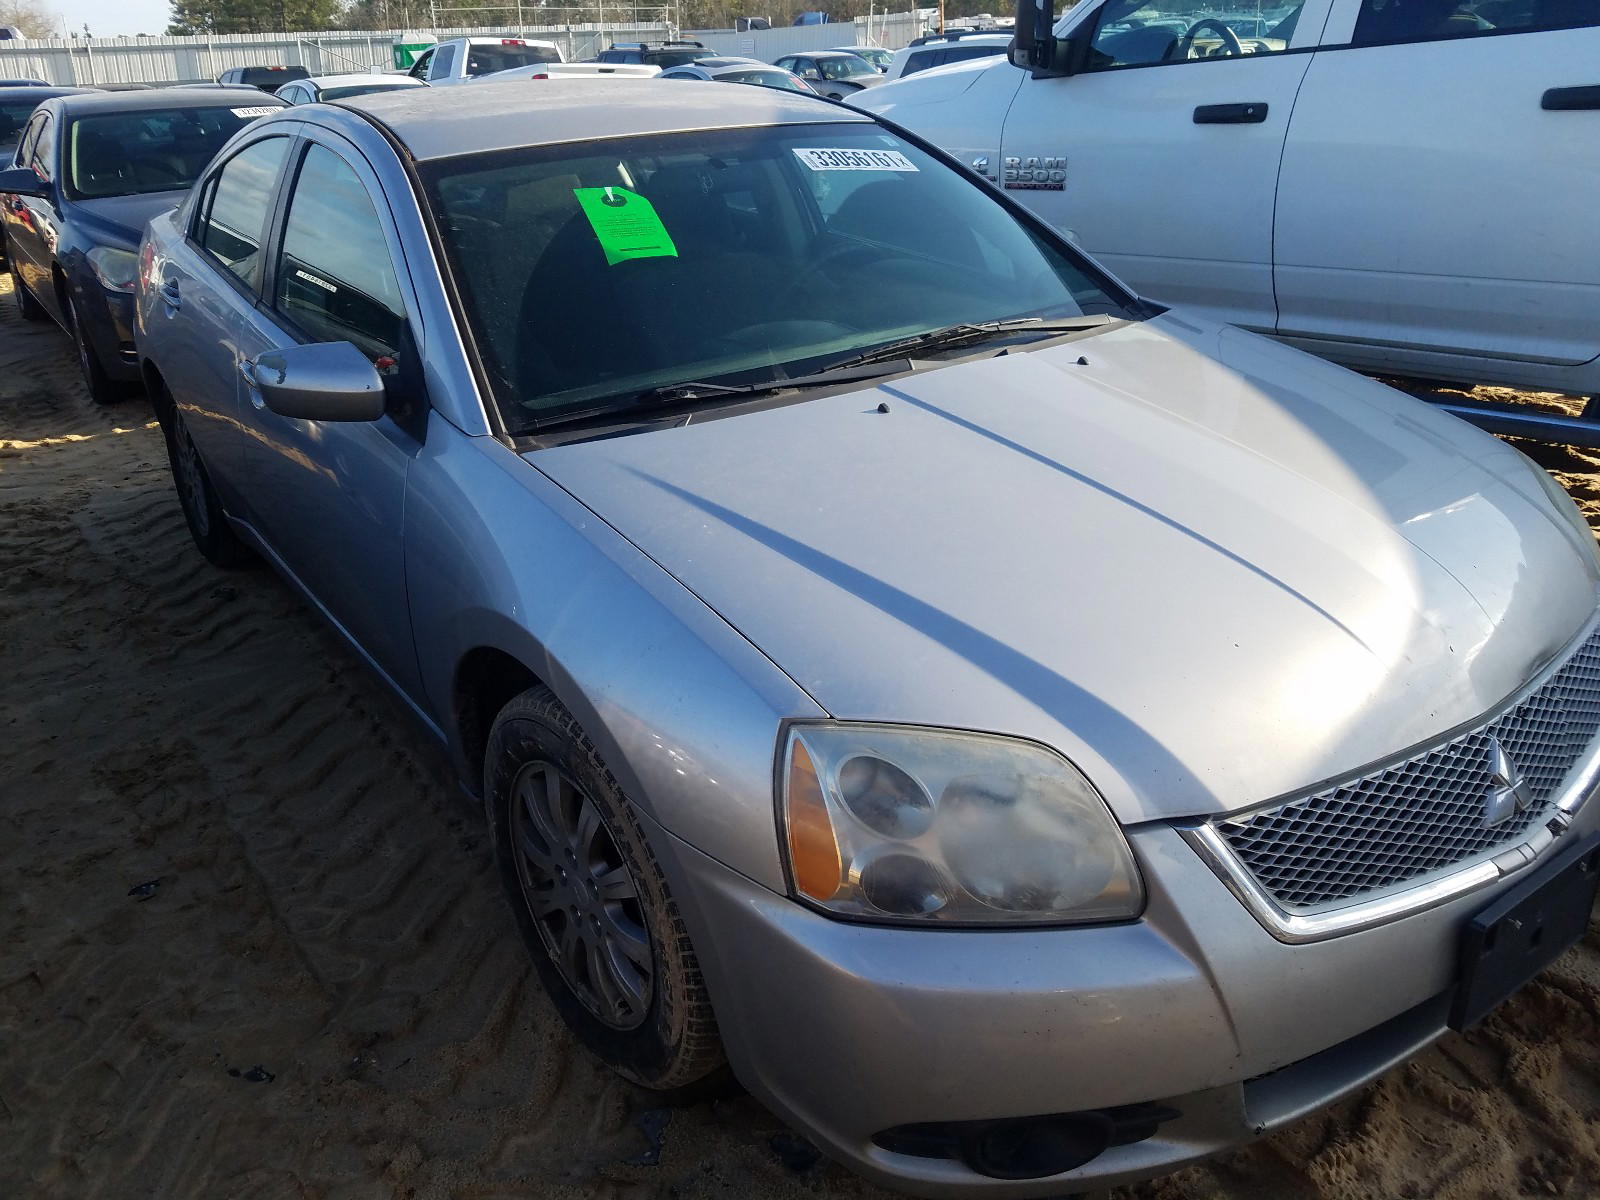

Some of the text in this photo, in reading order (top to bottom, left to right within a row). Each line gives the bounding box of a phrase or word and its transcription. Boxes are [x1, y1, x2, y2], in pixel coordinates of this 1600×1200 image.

[810, 151, 900, 167] 33056161
[1005, 156, 1067, 169] RAM
[1005, 169, 1066, 182] 3500
